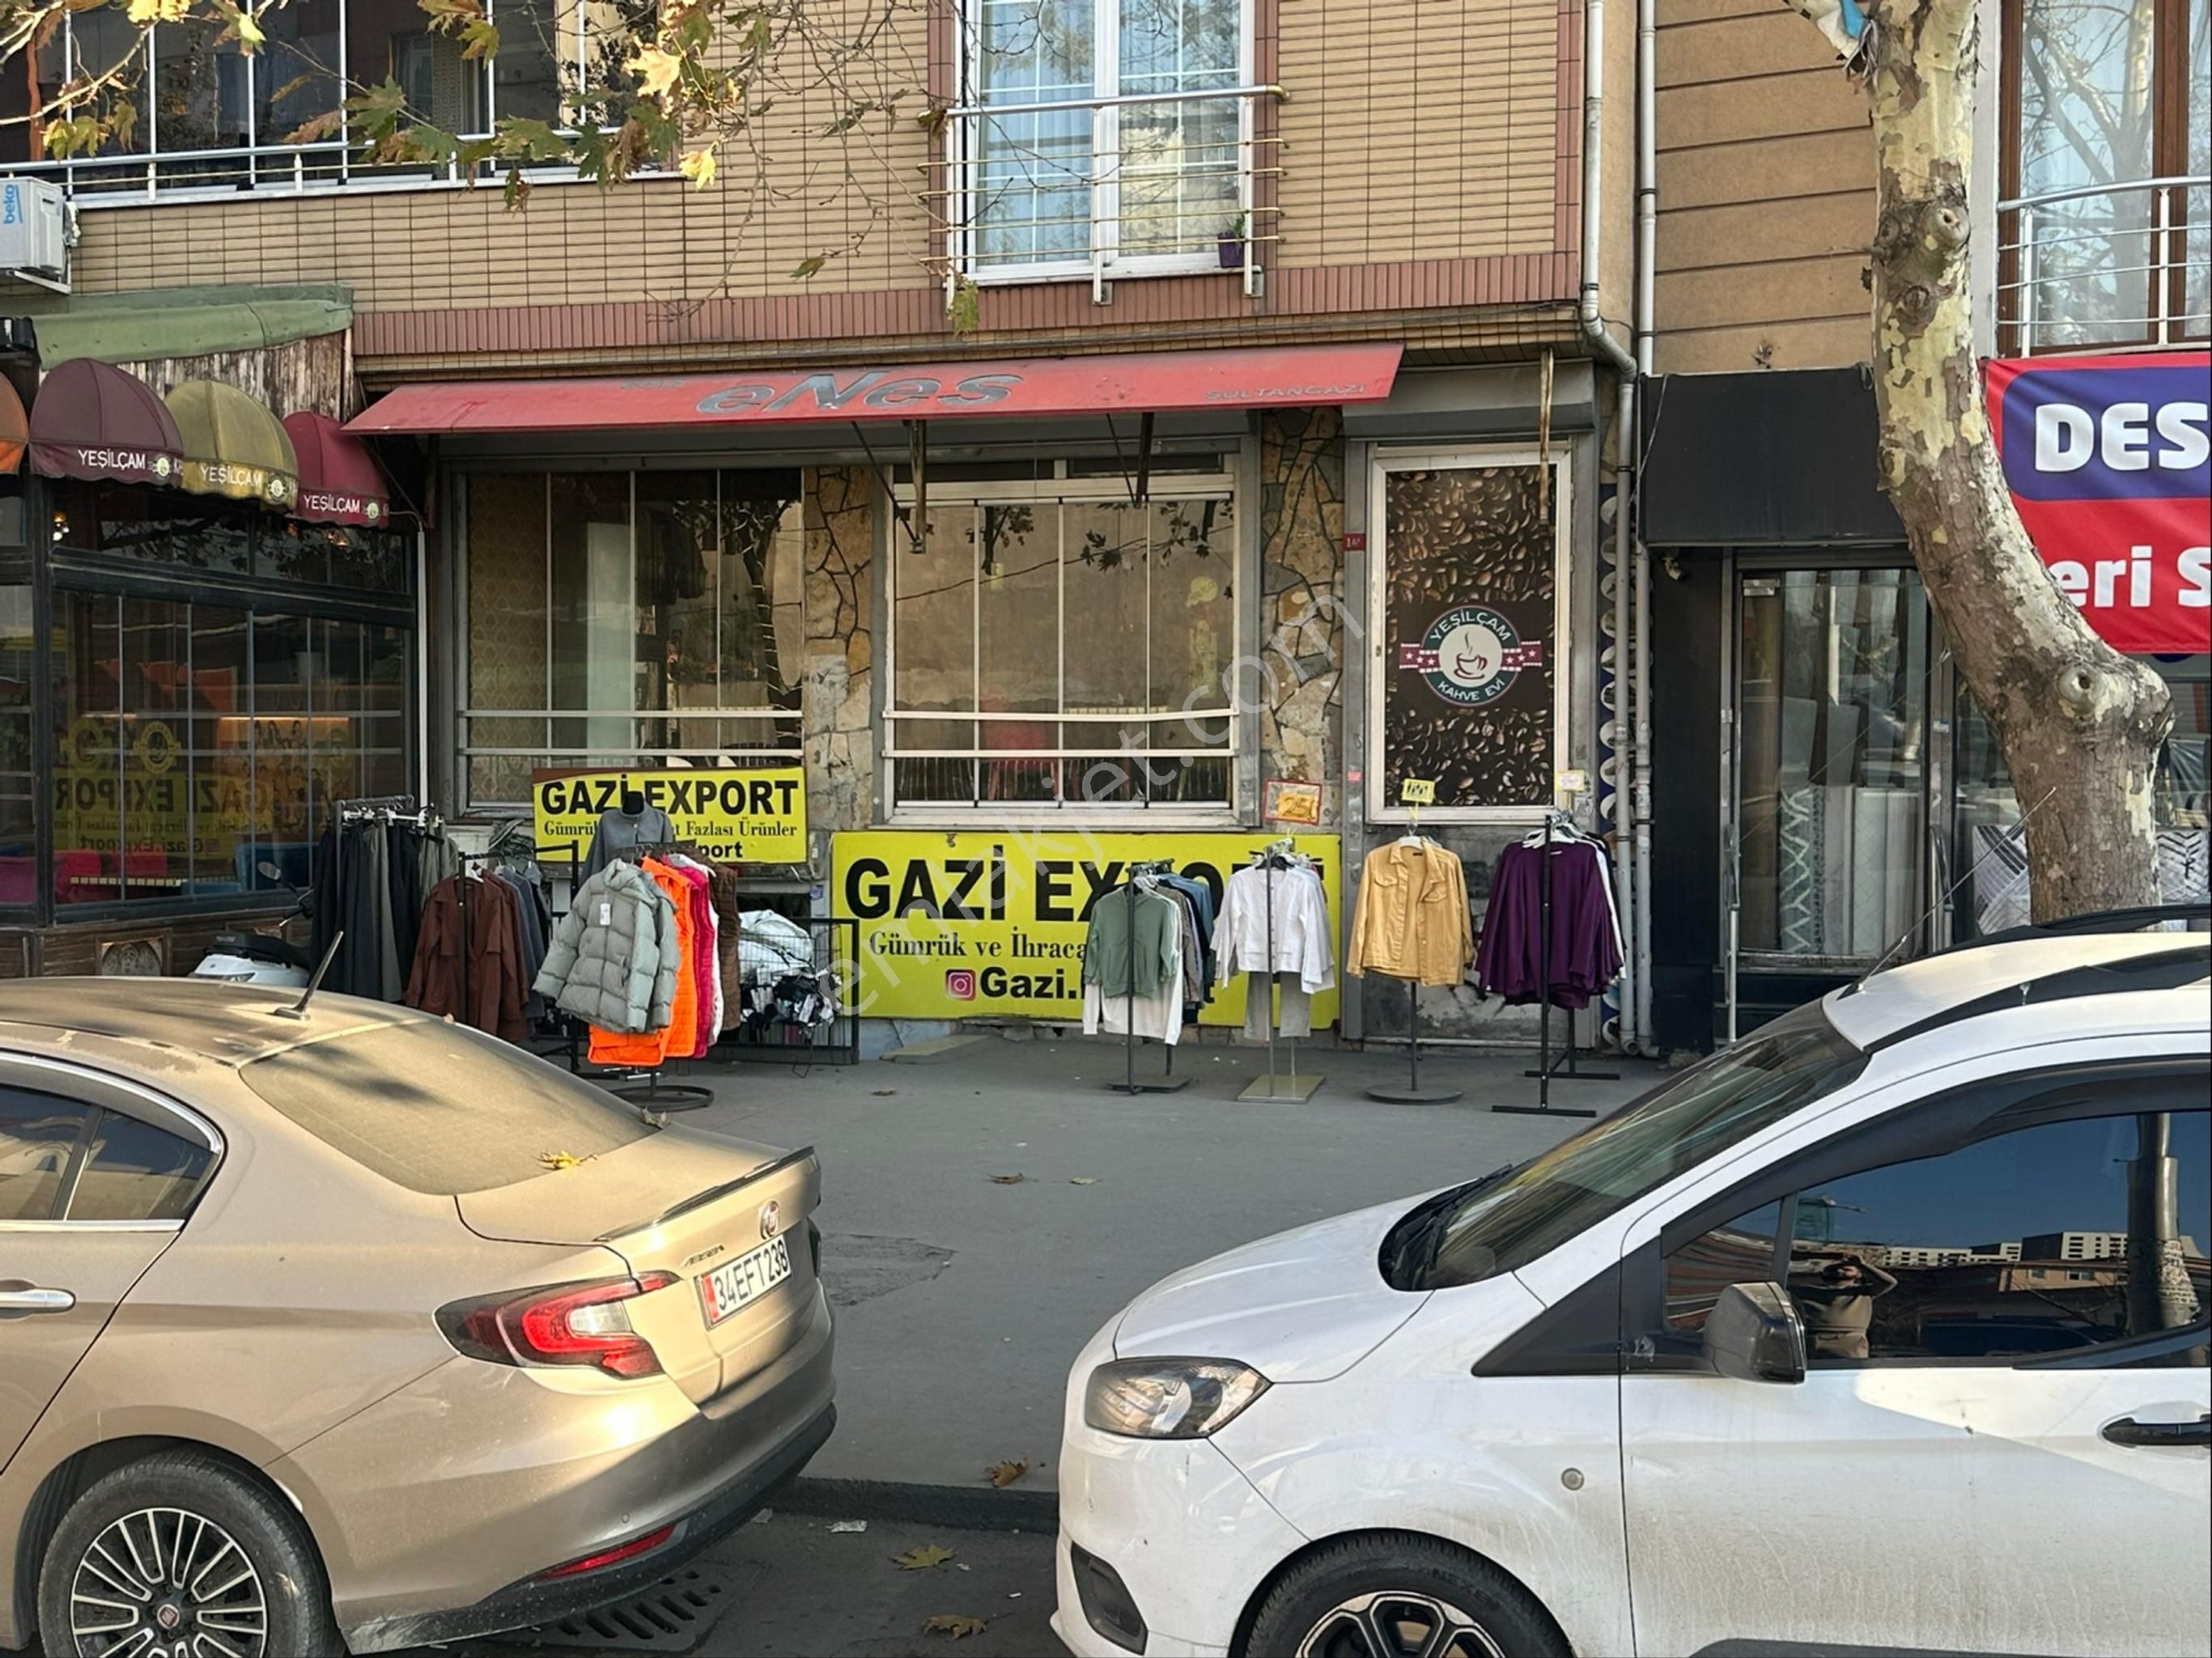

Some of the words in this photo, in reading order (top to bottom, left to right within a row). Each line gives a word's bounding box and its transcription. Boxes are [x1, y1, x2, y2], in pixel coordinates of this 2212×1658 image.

[3, 184, 15, 224] beko
[2034, 401, 2210, 473] DES
[78, 449, 146, 471] YEŞİLÇAM
[200, 464, 262, 489] YEŞİLÇAM
[304, 494, 361, 514] YEŞİLÇAM
[1429, 609, 1512, 641] YEŞİLÇAM
[1437, 681, 1480, 702] KAHVE
[1484, 677, 1505, 697] EVİ
[541, 774, 627, 816] GAZİ
[643, 779, 799, 816] EXPORT
[687, 820, 733, 837] Fazlası
[738, 816, 798, 837] Ürünler
[845, 844, 1006, 921] GAZİ
[869, 931, 967, 957] Gümrük
[975, 940, 1002, 957] ve
[1011, 926, 1086, 960] İhraca
